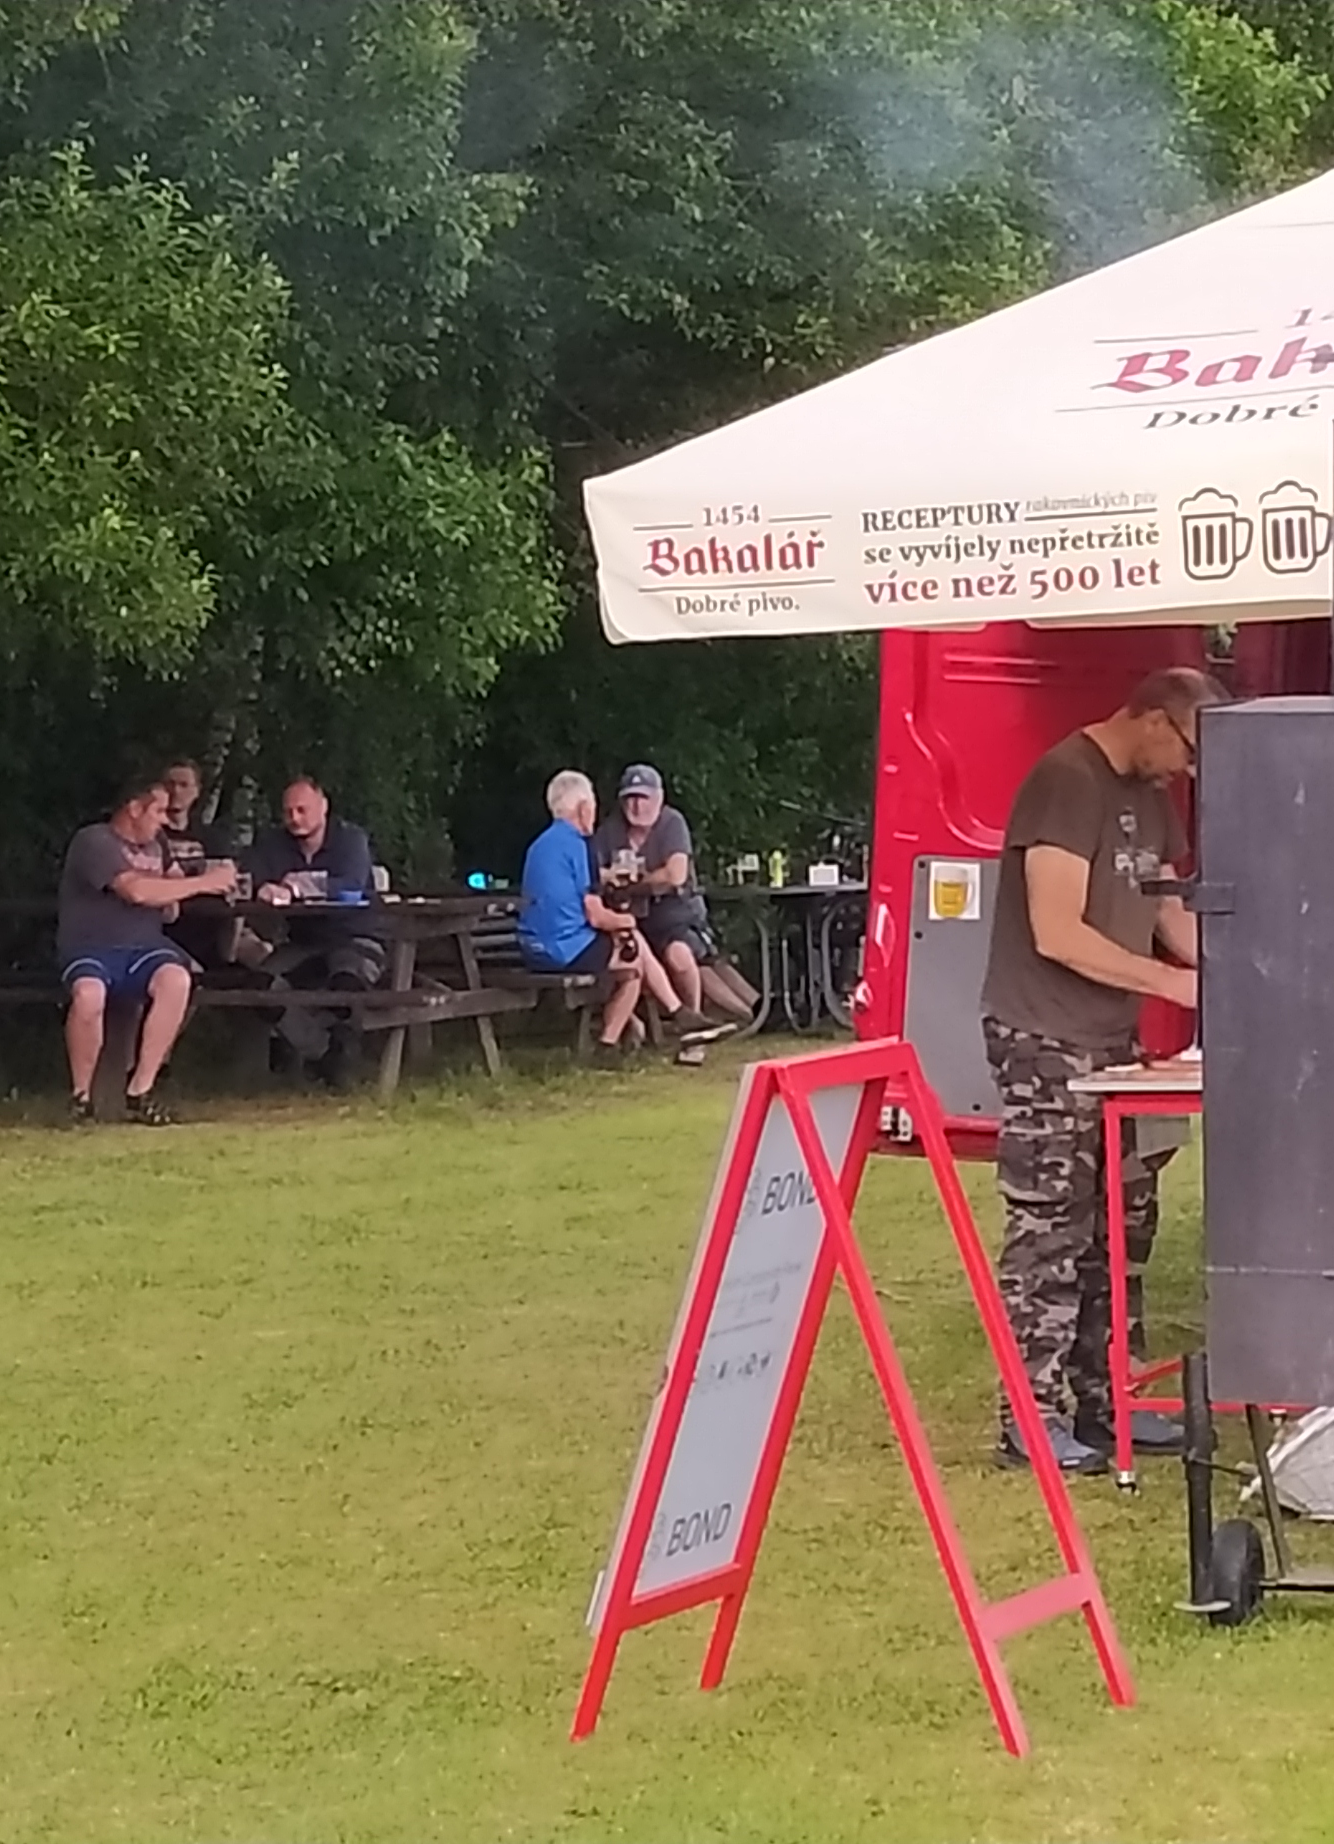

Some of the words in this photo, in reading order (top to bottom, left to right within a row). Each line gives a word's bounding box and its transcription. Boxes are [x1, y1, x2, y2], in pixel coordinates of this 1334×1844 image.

[1143, 394, 1320, 430] Dobré
[702, 503, 760, 528] 1454
[861, 501, 1020, 533] RECEPTURY
[642, 528, 826, 578] Bakalář
[863, 546, 893, 565] se
[898, 533, 1002, 568] vyvíjely
[1008, 522, 1161, 559] nepřetržitě
[863, 569, 940, 605] více
[950, 561, 1018, 600] než
[1029, 564, 1101, 601] 500
[1111, 557, 1162, 590] let
[675, 592, 742, 616] Dobré
[747, 591, 801, 617] pivo.
[666, 1502, 733, 1558] BOND
